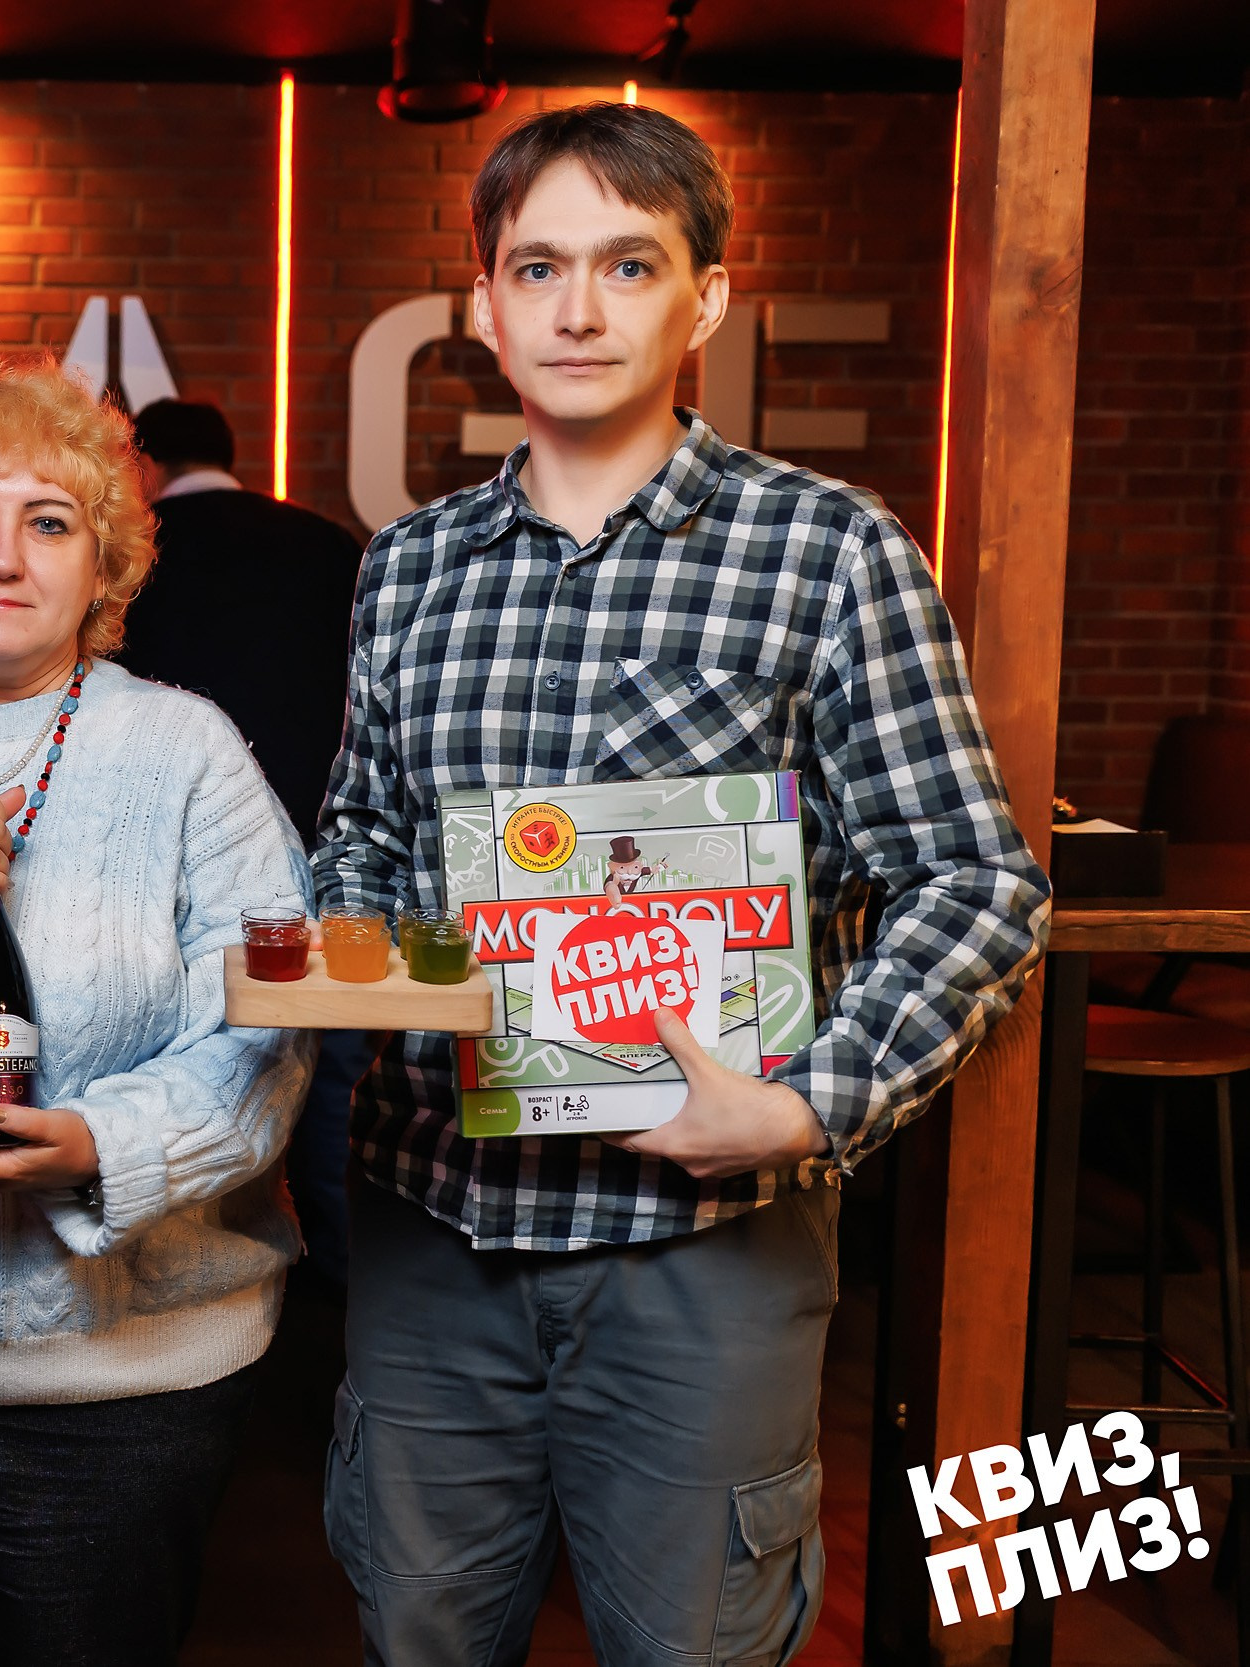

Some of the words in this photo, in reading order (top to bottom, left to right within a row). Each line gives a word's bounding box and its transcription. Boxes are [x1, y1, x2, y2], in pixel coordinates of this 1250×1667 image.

[553, 926, 696, 988] КВИЗ,
[557, 964, 700, 1027] ПЛИЗ!
[532, 1106, 550, 1122] 8+
